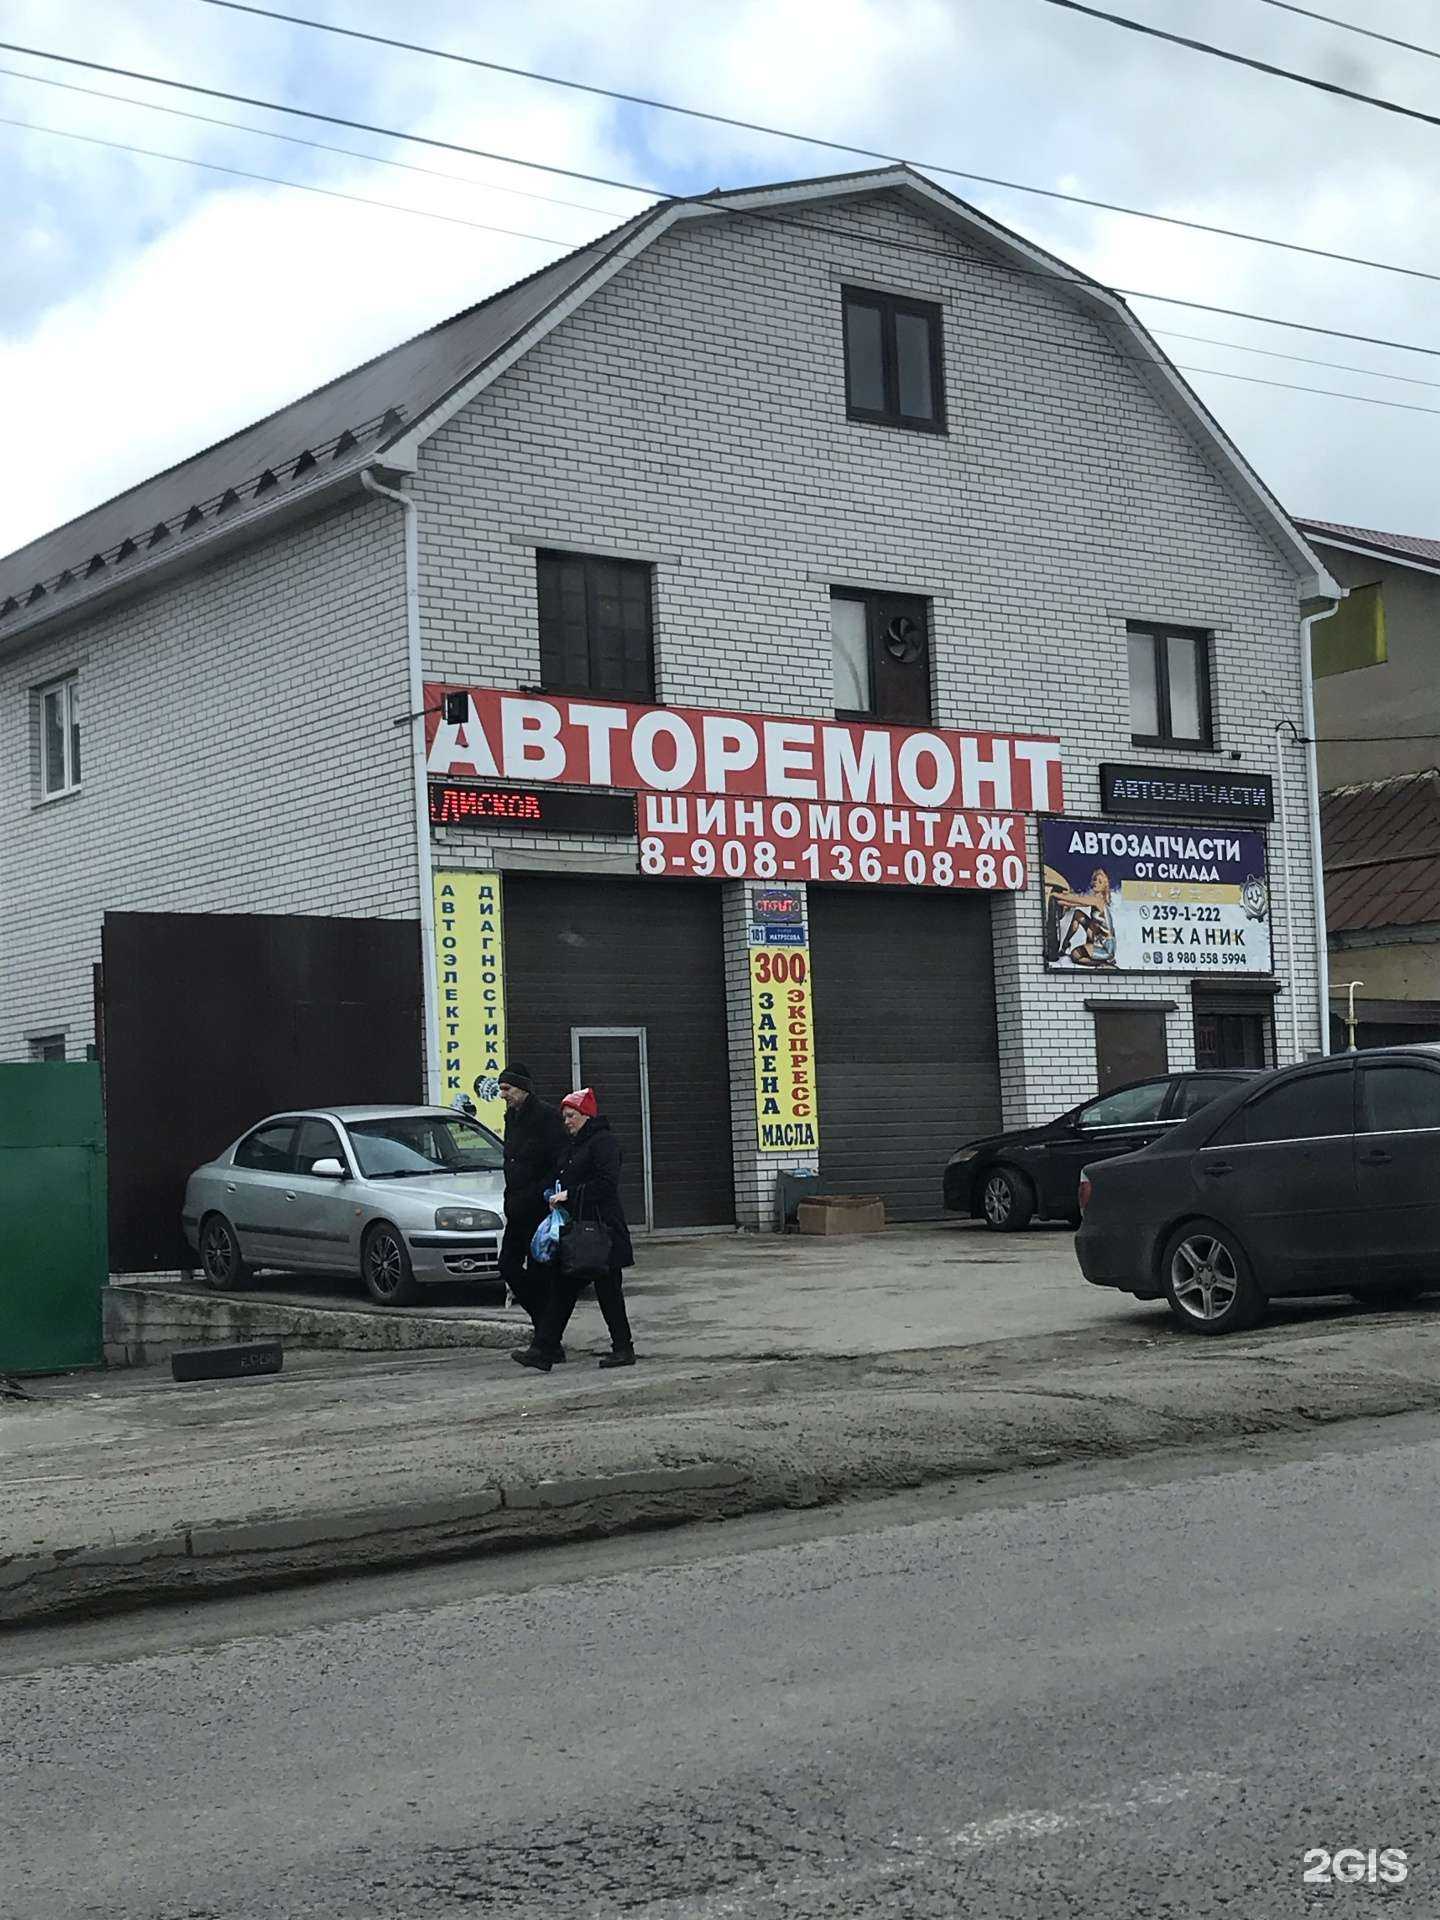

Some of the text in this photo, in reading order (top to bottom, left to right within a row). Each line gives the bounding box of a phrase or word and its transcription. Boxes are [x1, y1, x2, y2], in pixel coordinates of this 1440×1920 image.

[427, 693, 1060, 812] АВТОРЕМОНТ
[1113, 780, 1266, 806] АВТОЗАПЧАСТИ
[646, 795, 1015, 850] ШИНОМОНТАЖ
[641, 837, 1024, 890] 8-908-136-08-80
[1068, 831, 1241, 862] АВТОЗАПЧАСТИ
[1135, 863, 1220, 881] ОТ СКЛАДА
[1153, 905, 1221, 922] 239-1-222
[1142, 926, 1246, 946] МЕХАНИК
[479, 886, 499, 1070] ДИАГНОСТИКА
[1167, 952, 1246, 965] 8 980 558 5994
[441, 885, 461, 1088] АВТОЭЛЕКТРИК
[758, 992, 780, 1115] ЗАМЕНА
[787, 989, 810, 1117] ЭКСПРЕСС
[762, 1123, 815, 1147] МАСЛА
